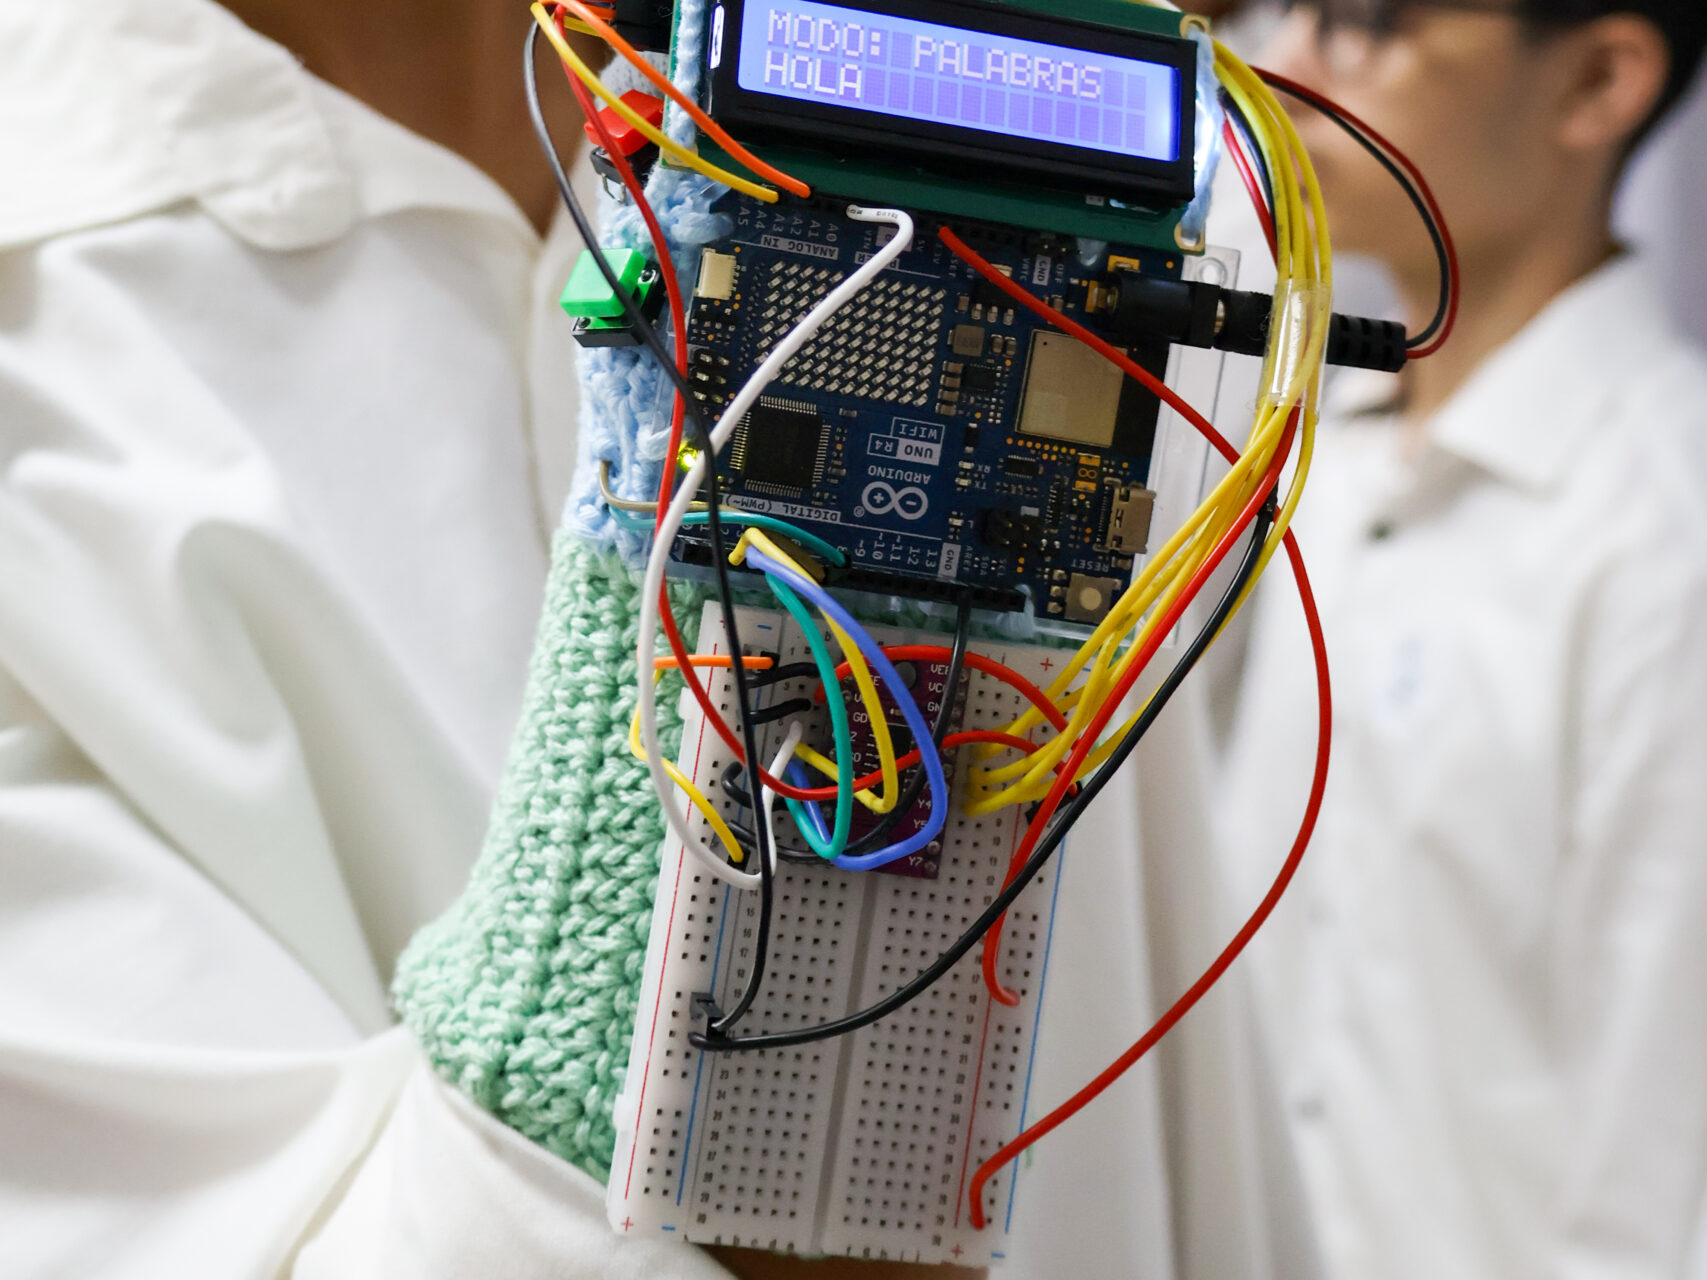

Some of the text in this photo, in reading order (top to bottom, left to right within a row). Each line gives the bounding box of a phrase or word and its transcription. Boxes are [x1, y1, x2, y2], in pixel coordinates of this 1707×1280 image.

[767, 8, 1103, 100] MODO: PALABRAS
[764, 50, 863, 100] HOLA
[737, 206, 751, 227] A5
[754, 209, 768, 230] A4
[772, 213, 786, 233] A3
[789, 216, 804, 236] A2
[807, 219, 822, 238] A1
[825, 223, 840, 242] A0
[762, 235, 838, 259] ANALOG IN
[1036, 260, 1047, 282] GND
[1054, 263, 1065, 284] OFF
[898, 423, 939, 440] WIFI
[873, 439, 934, 459] UNO R4
[867, 464, 932, 485] ARDUINO
[782, 504, 839, 522] DIGITAL
[906, 545, 921, 566] 12
[925, 548, 939, 569] 13
[944, 548, 955, 572] GND
[1071, 558, 1110, 573] RESET
[908, 855, 924, 868] Y7
